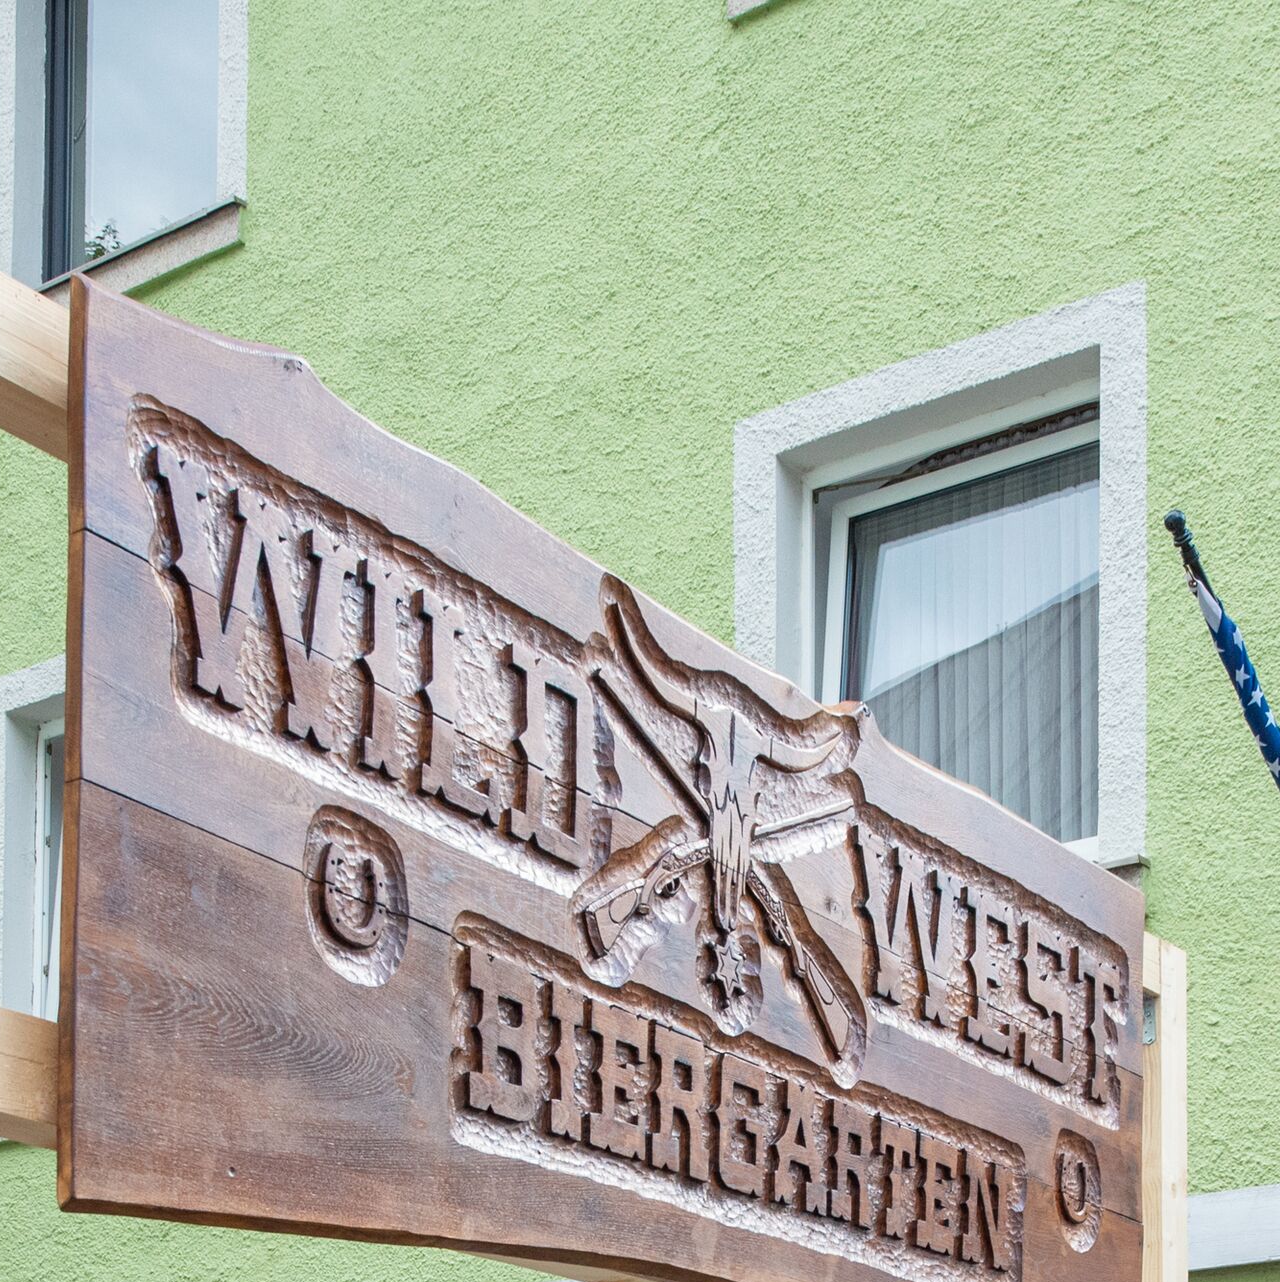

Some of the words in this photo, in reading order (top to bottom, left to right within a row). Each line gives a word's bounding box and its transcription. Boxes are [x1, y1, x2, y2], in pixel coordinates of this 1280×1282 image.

[148, 443, 602, 870] WILD
[846, 823, 1122, 1108] WEST
[464, 942, 1018, 1273] BIERGARTEN
